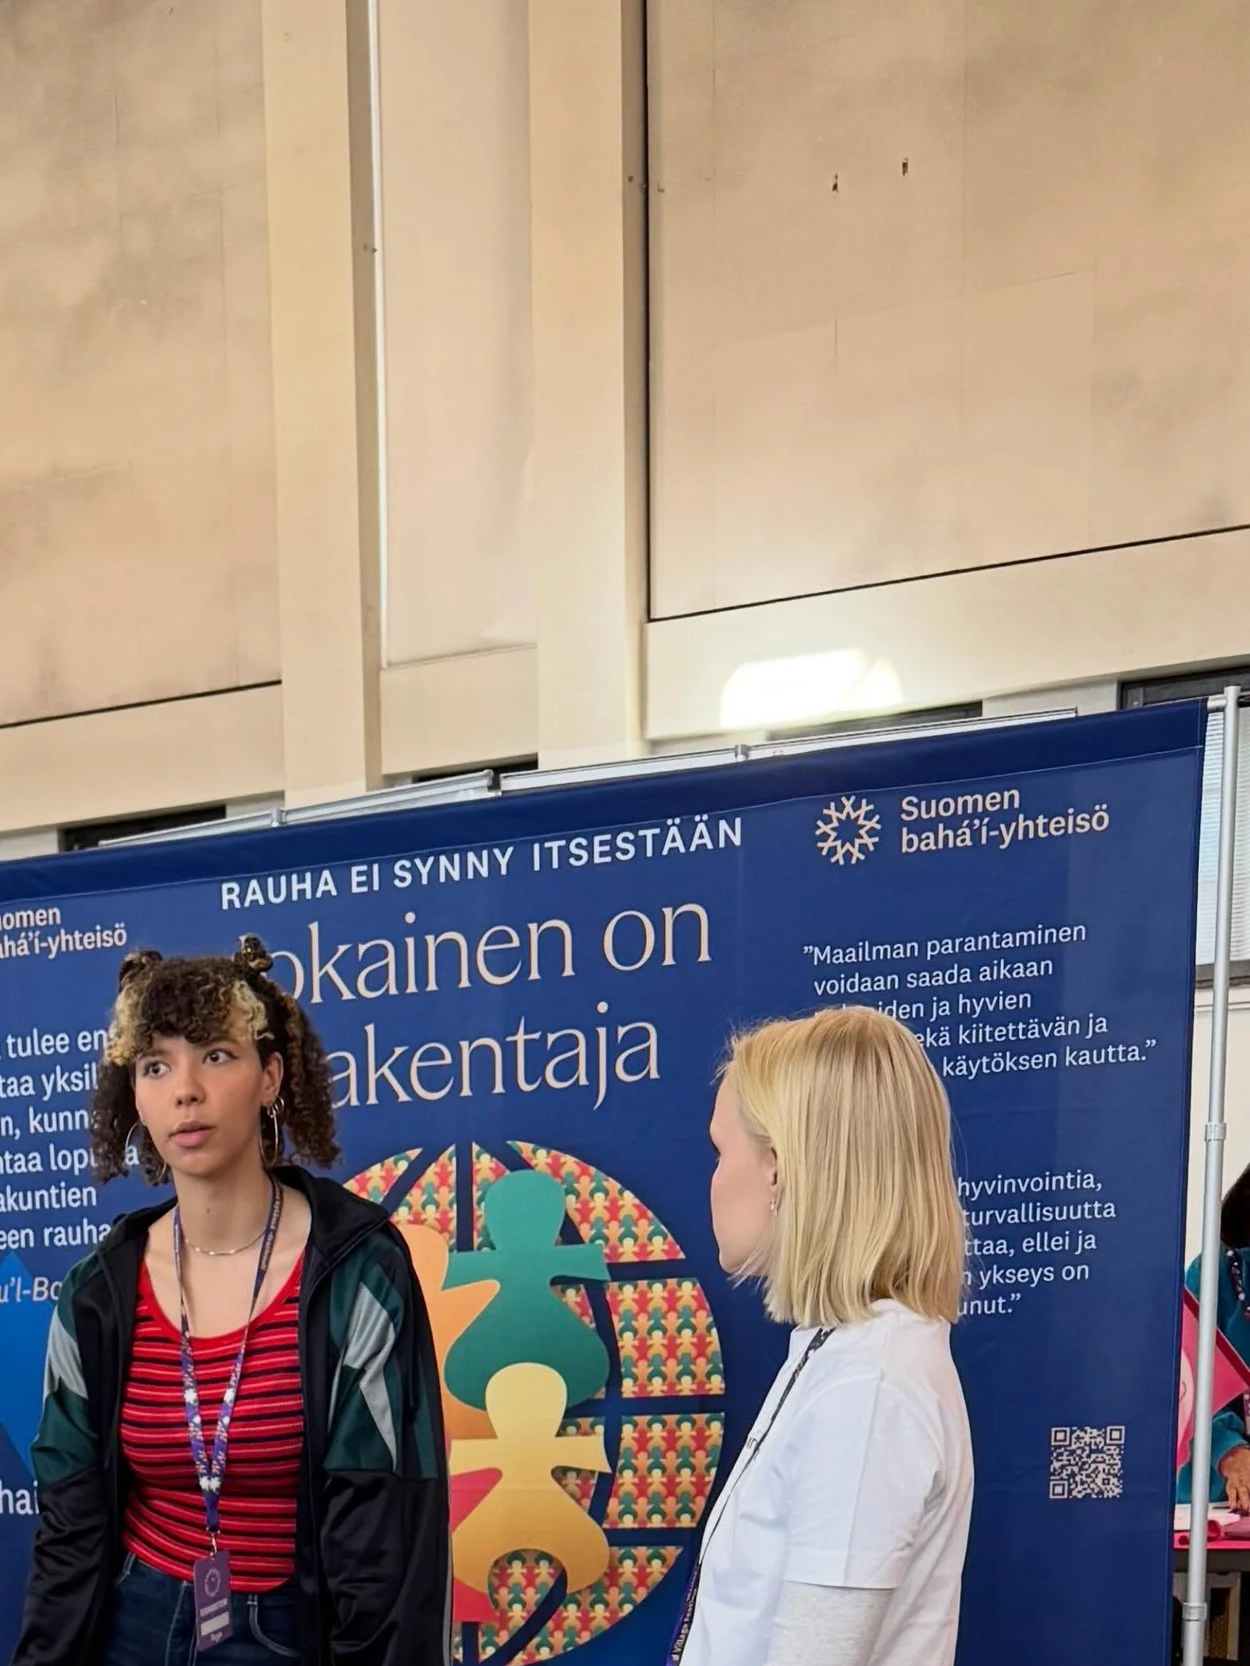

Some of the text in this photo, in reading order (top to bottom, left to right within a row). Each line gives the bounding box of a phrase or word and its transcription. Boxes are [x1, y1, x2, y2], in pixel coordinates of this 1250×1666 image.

[900, 788, 1021, 821] Suomen
[901, 804, 1110, 854] bahá’í-yhteisö
[221, 814, 743, 911] RAUHA EI SYNNY ITSESTÄÄN
[239, 902, 713, 1005] okainen on
[926, 924, 1087, 962] parantaminen
[814, 957, 1054, 997] voidaan saada aikaan
[929, 996, 951, 1022] ja
[958, 990, 1032, 1021] hyvien
[6, 1028, 70, 1058] tulee
[915, 1014, 1109, 1048] ekä kiitettävän ja
[327, 1002, 662, 1112] akentaja
[942, 1050, 1058, 1081] käytöksen
[42, 1063, 99, 1100] yksil
[29, 1107, 95, 1135] kunn
[1022, 1230, 1070, 1253] ellei
[1078, 1229, 1097, 1255] ja
[979, 1264, 1055, 1290] ykseys
[1062, 1262, 1089, 1281] on
